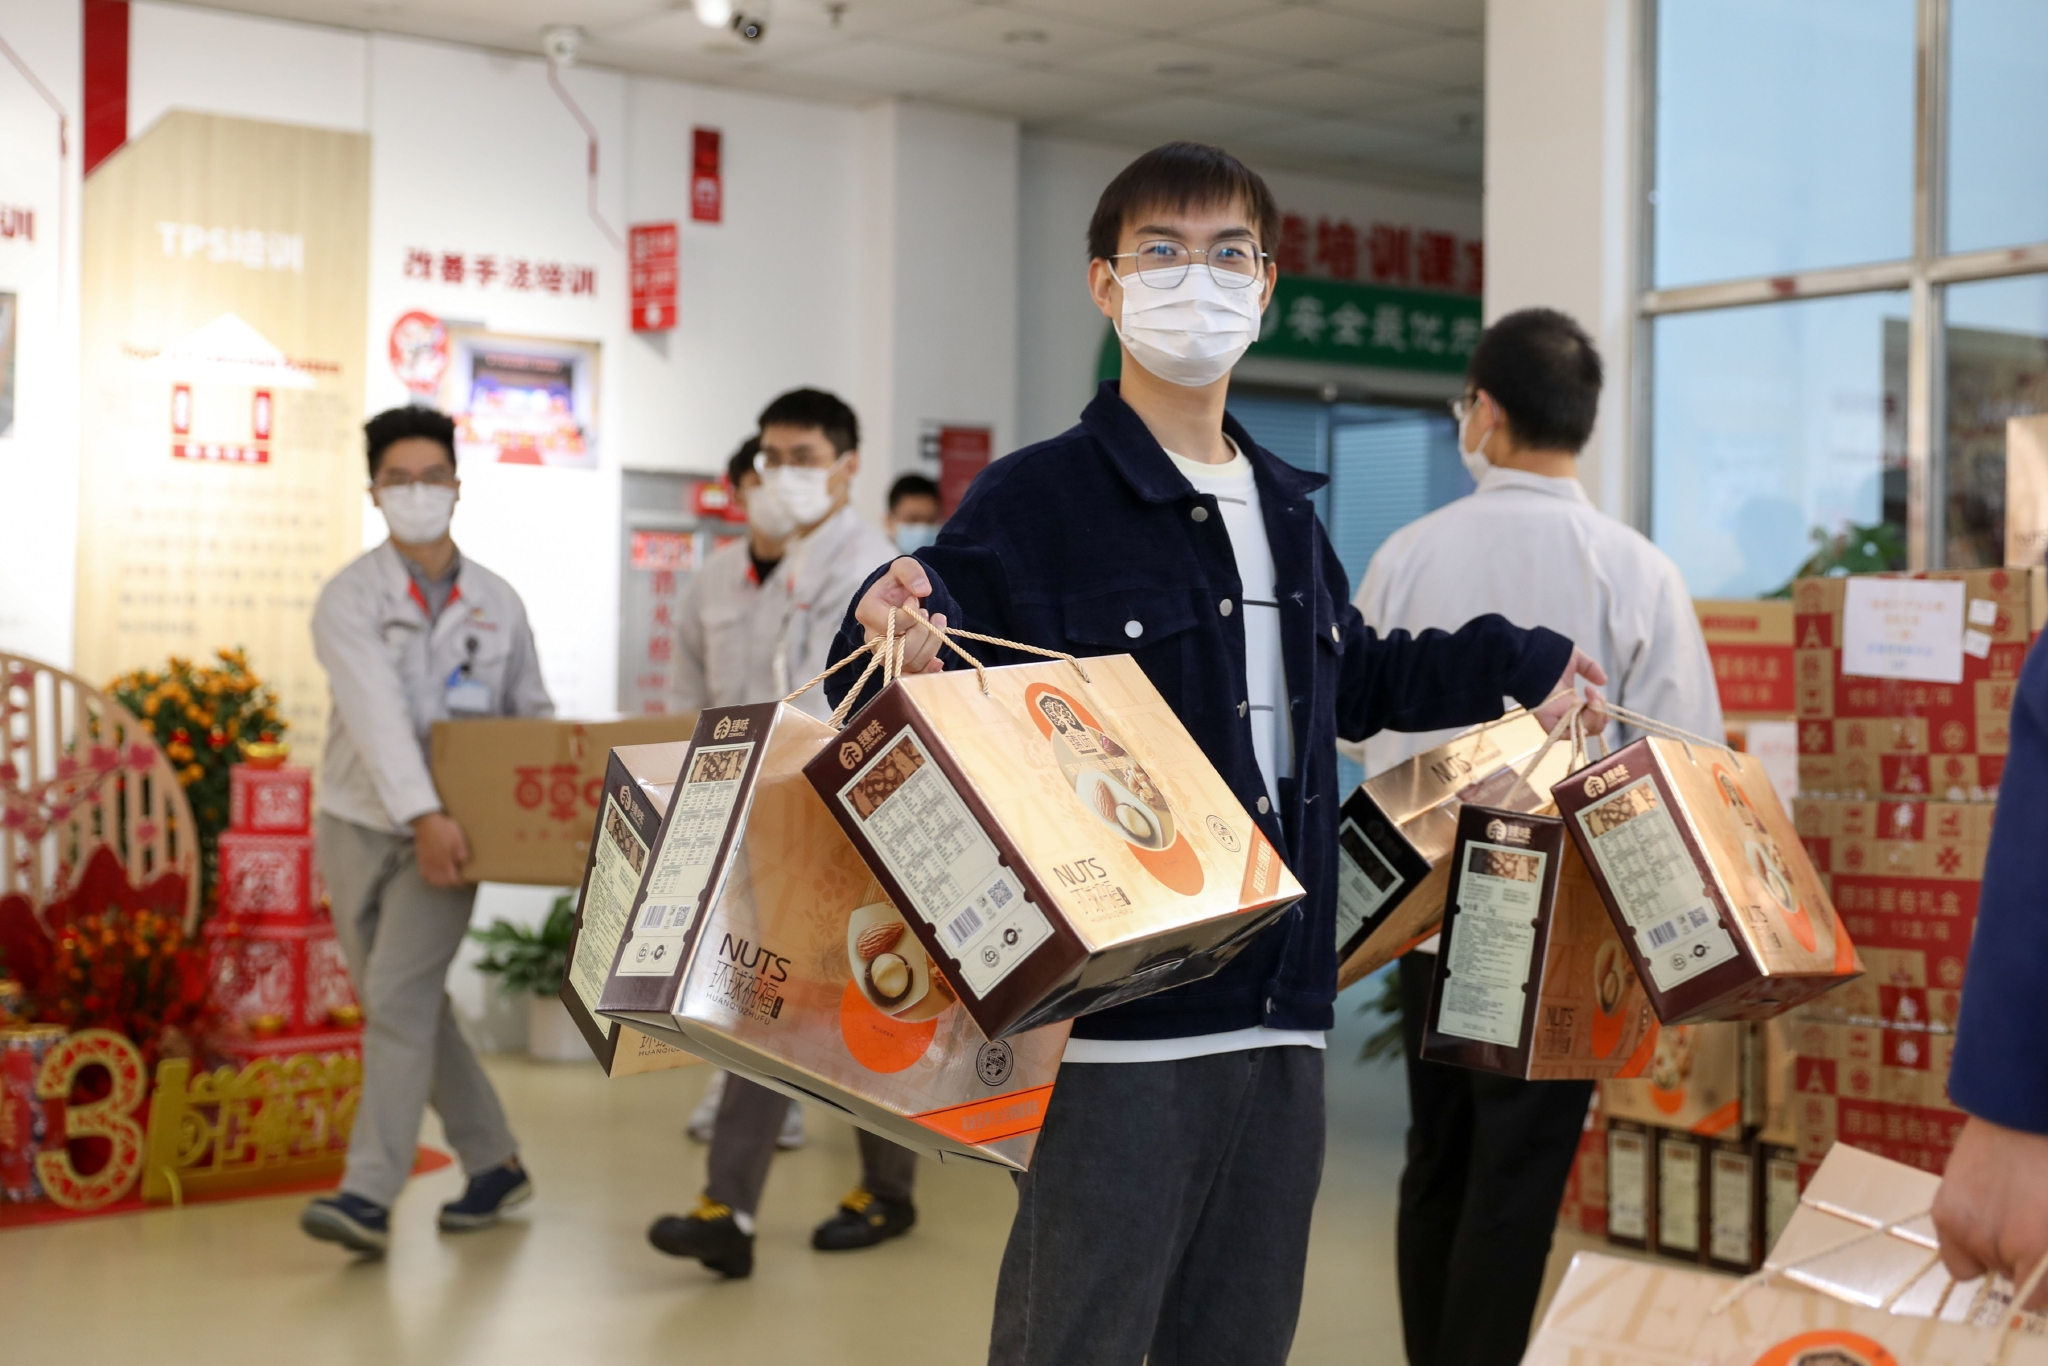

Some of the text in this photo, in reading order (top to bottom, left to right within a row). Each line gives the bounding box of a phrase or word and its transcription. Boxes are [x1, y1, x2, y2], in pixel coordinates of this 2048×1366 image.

[403, 249, 597, 295] 改善手法培训
[856, 719, 884, 748] 臻味
[864, 731, 888, 753] ZENWELL
[1430, 752, 1472, 785] NUTS
[1053, 857, 1107, 888] NUTS
[1838, 884, 1961, 917] 原味蛋卷礼盒
[719, 932, 791, 982] NUTS
[708, 960, 779, 1016] 环球祝福
[706, 992, 771, 1026] HUANQIUZHUFU
